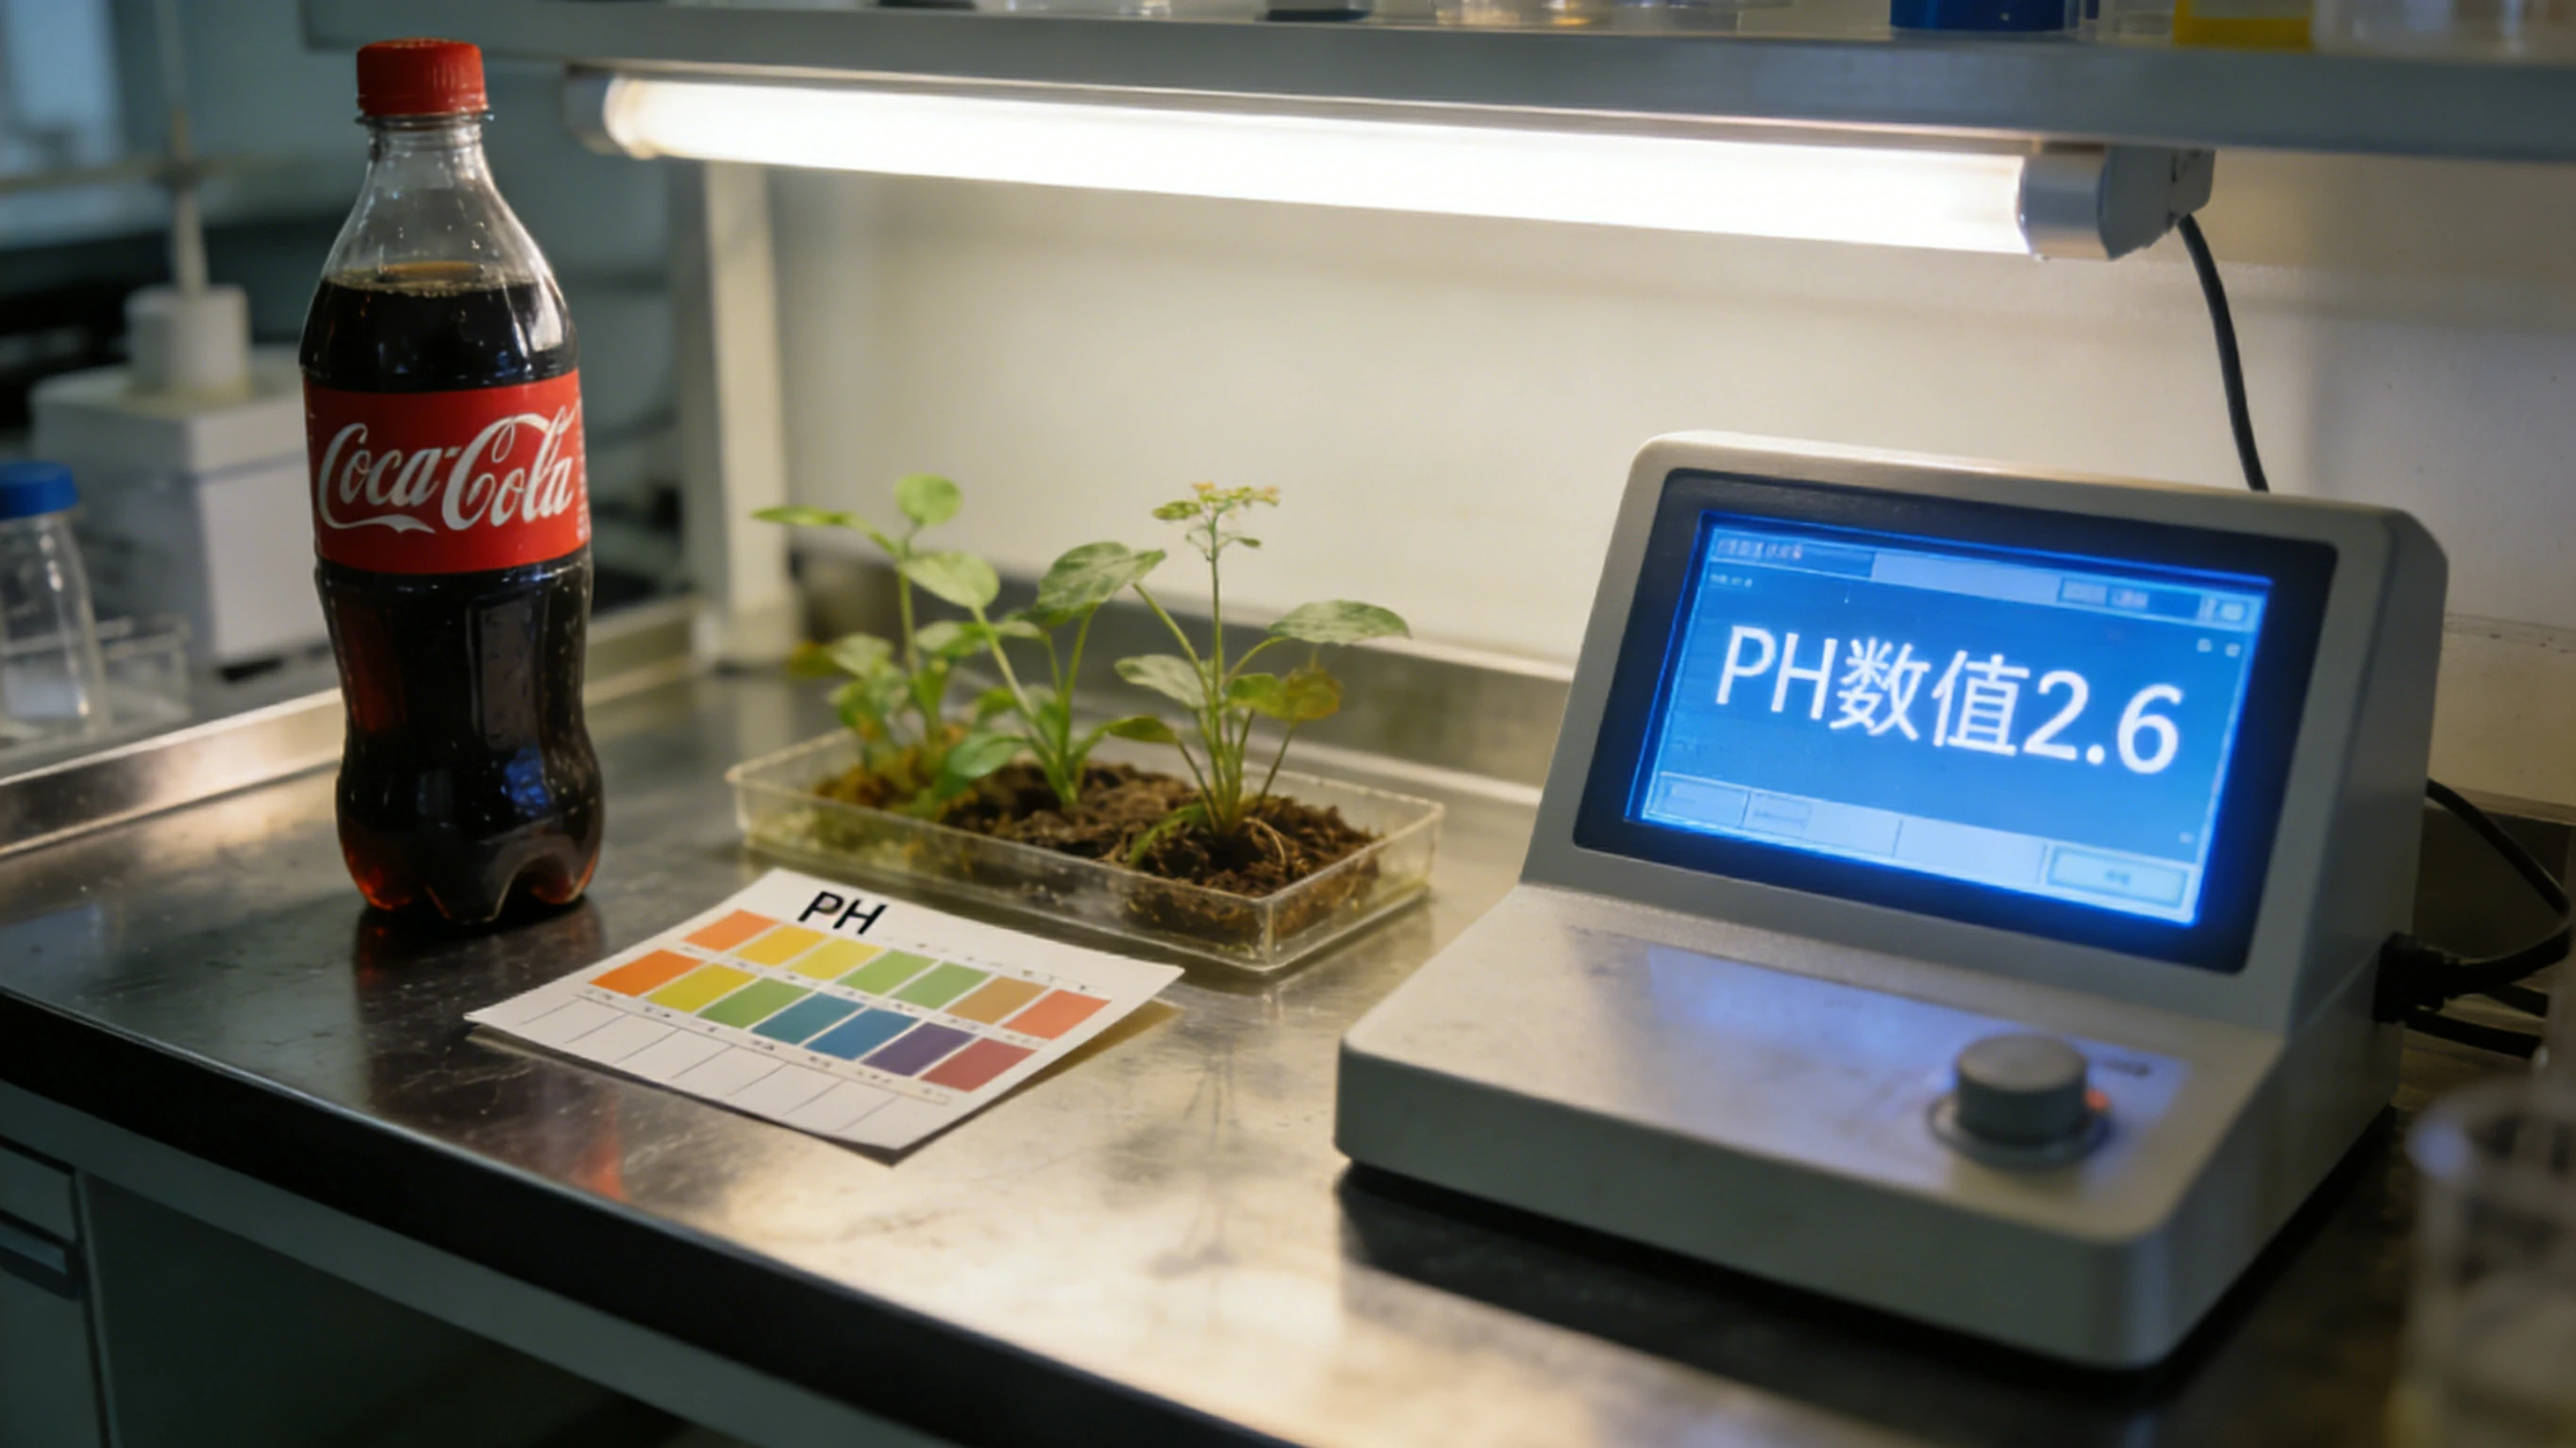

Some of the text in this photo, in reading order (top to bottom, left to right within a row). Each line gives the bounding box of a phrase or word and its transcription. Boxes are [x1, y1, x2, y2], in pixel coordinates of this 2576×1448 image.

[318, 405, 577, 534] Coca-Cola
[1715, 625, 2183, 774] PH数值2.6
[797, 890, 889, 936] PH
